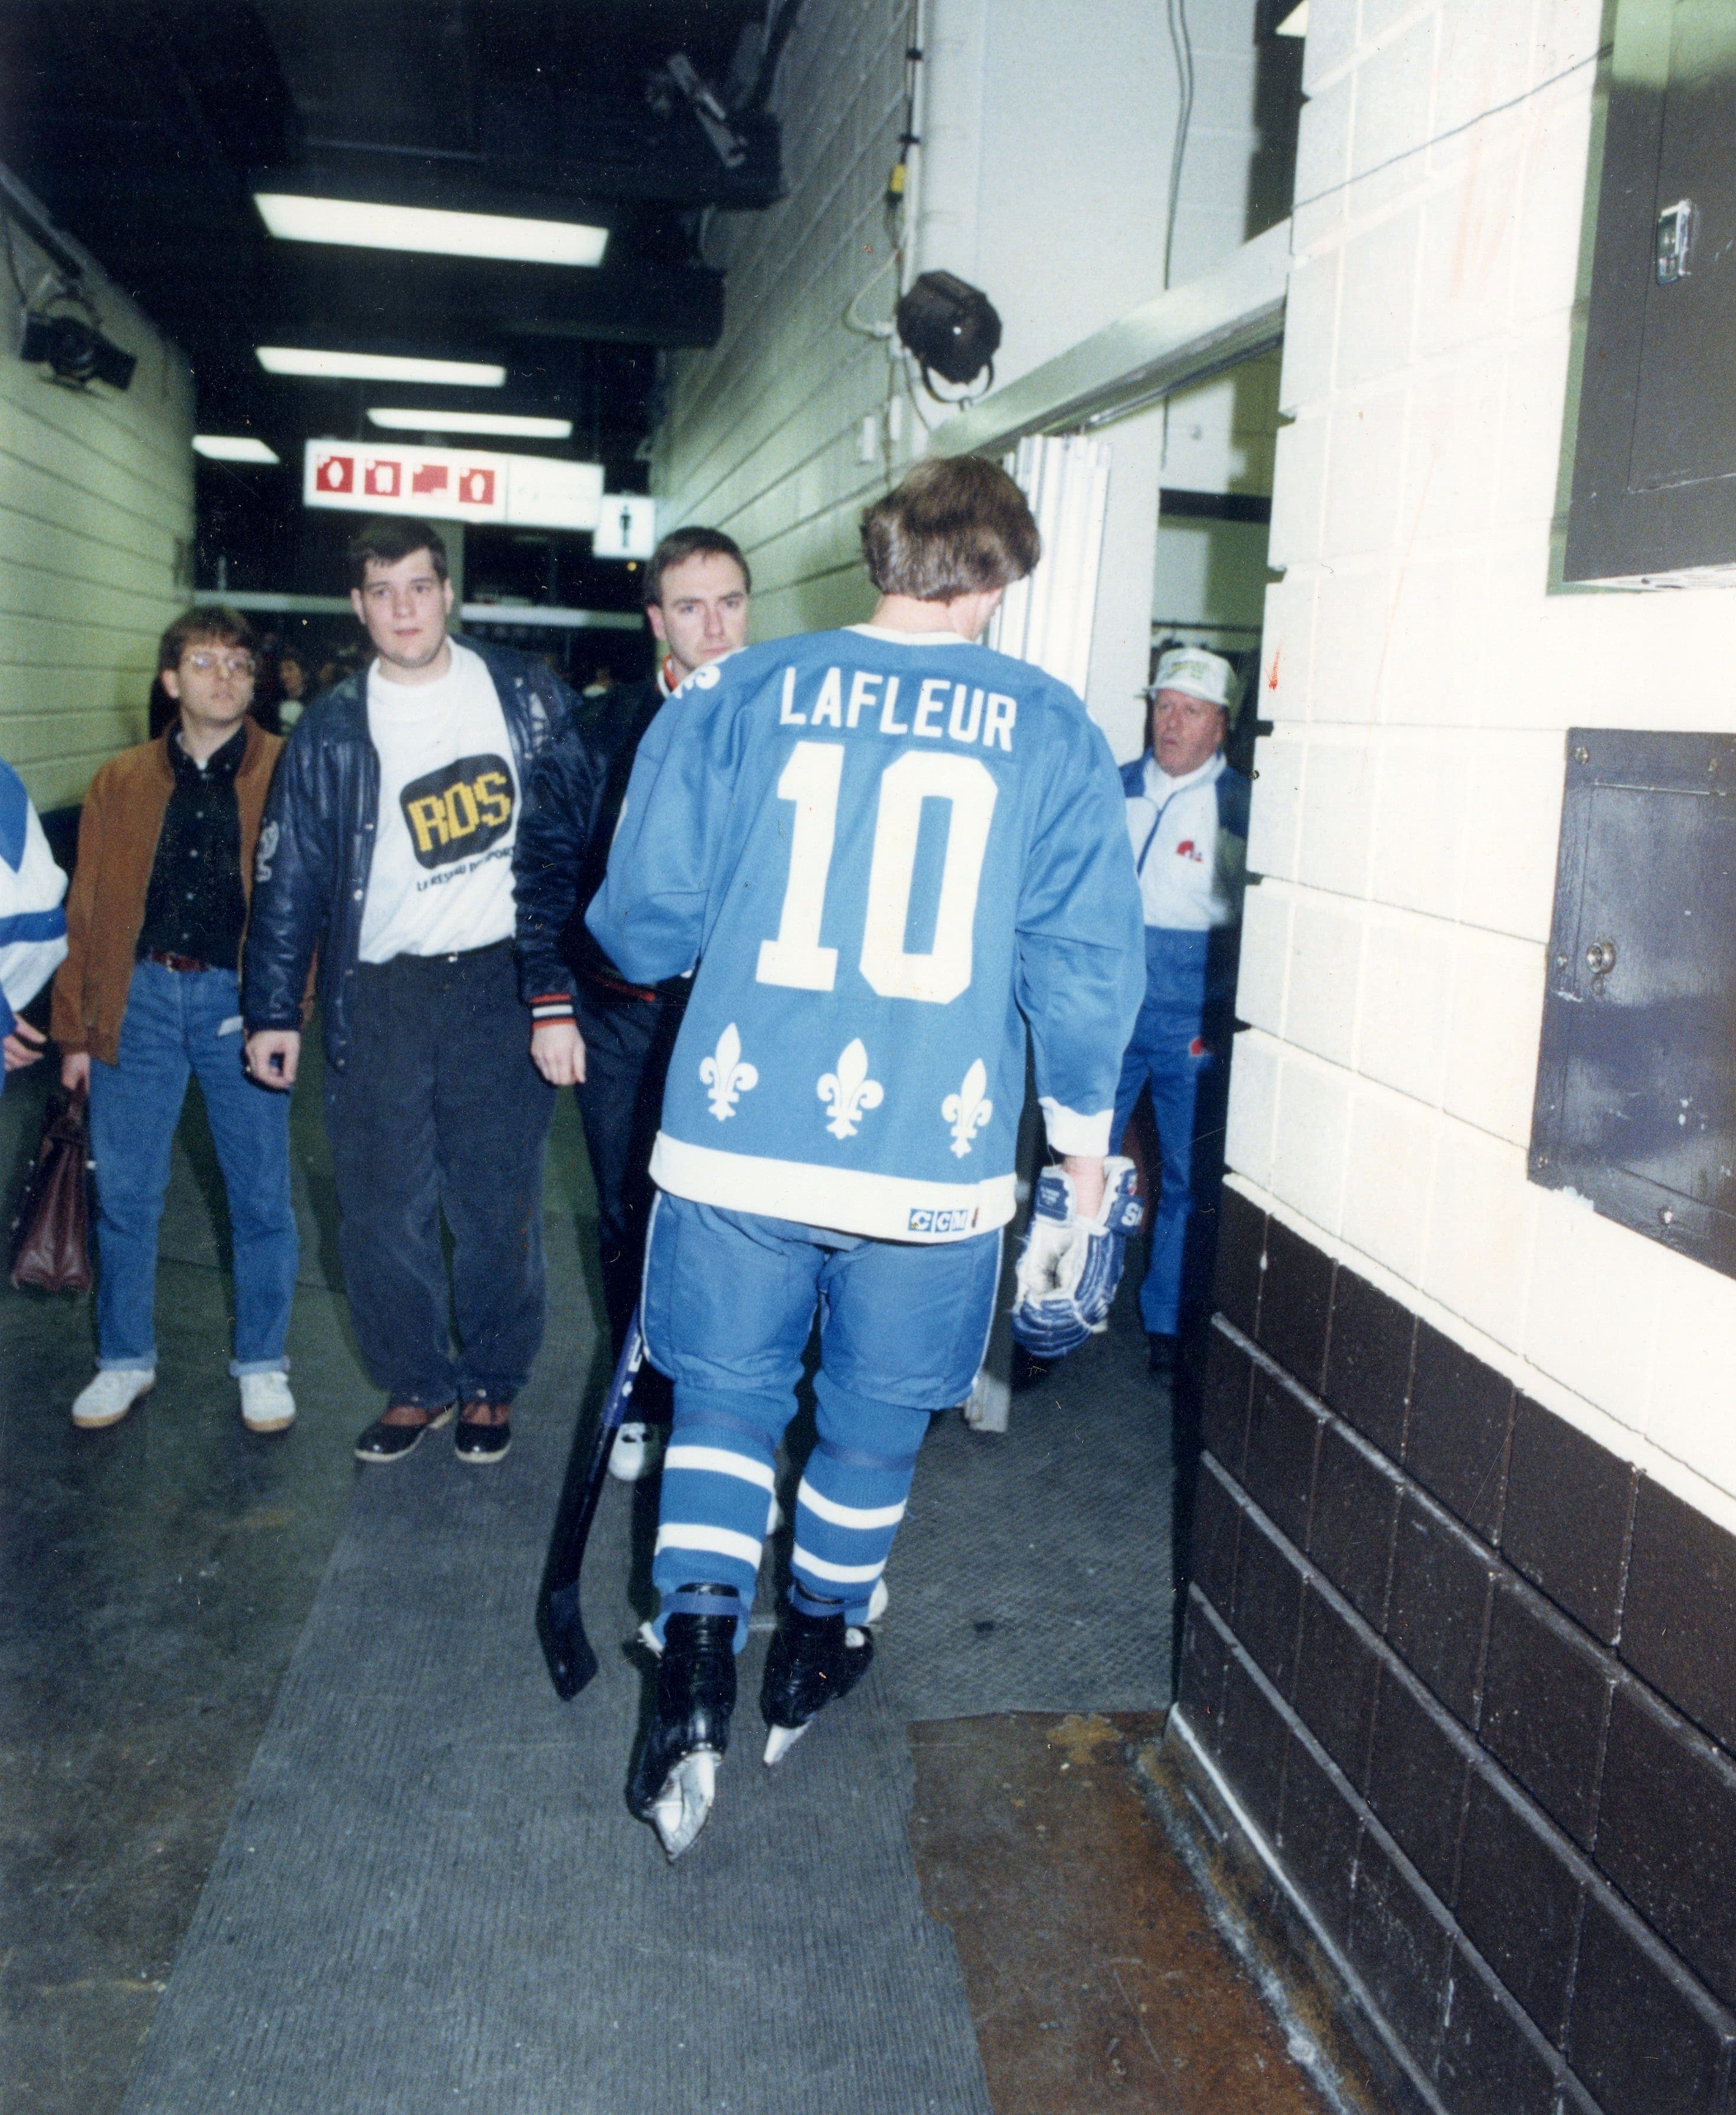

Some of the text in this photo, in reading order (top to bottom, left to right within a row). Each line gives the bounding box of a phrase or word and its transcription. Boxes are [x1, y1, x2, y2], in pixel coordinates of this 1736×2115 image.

[780, 667, 1016, 751] LAFLEUR
[407, 772, 511, 852] RDS
[756, 741, 999, 1005] 10
[910, 1210, 967, 1231] CCM
